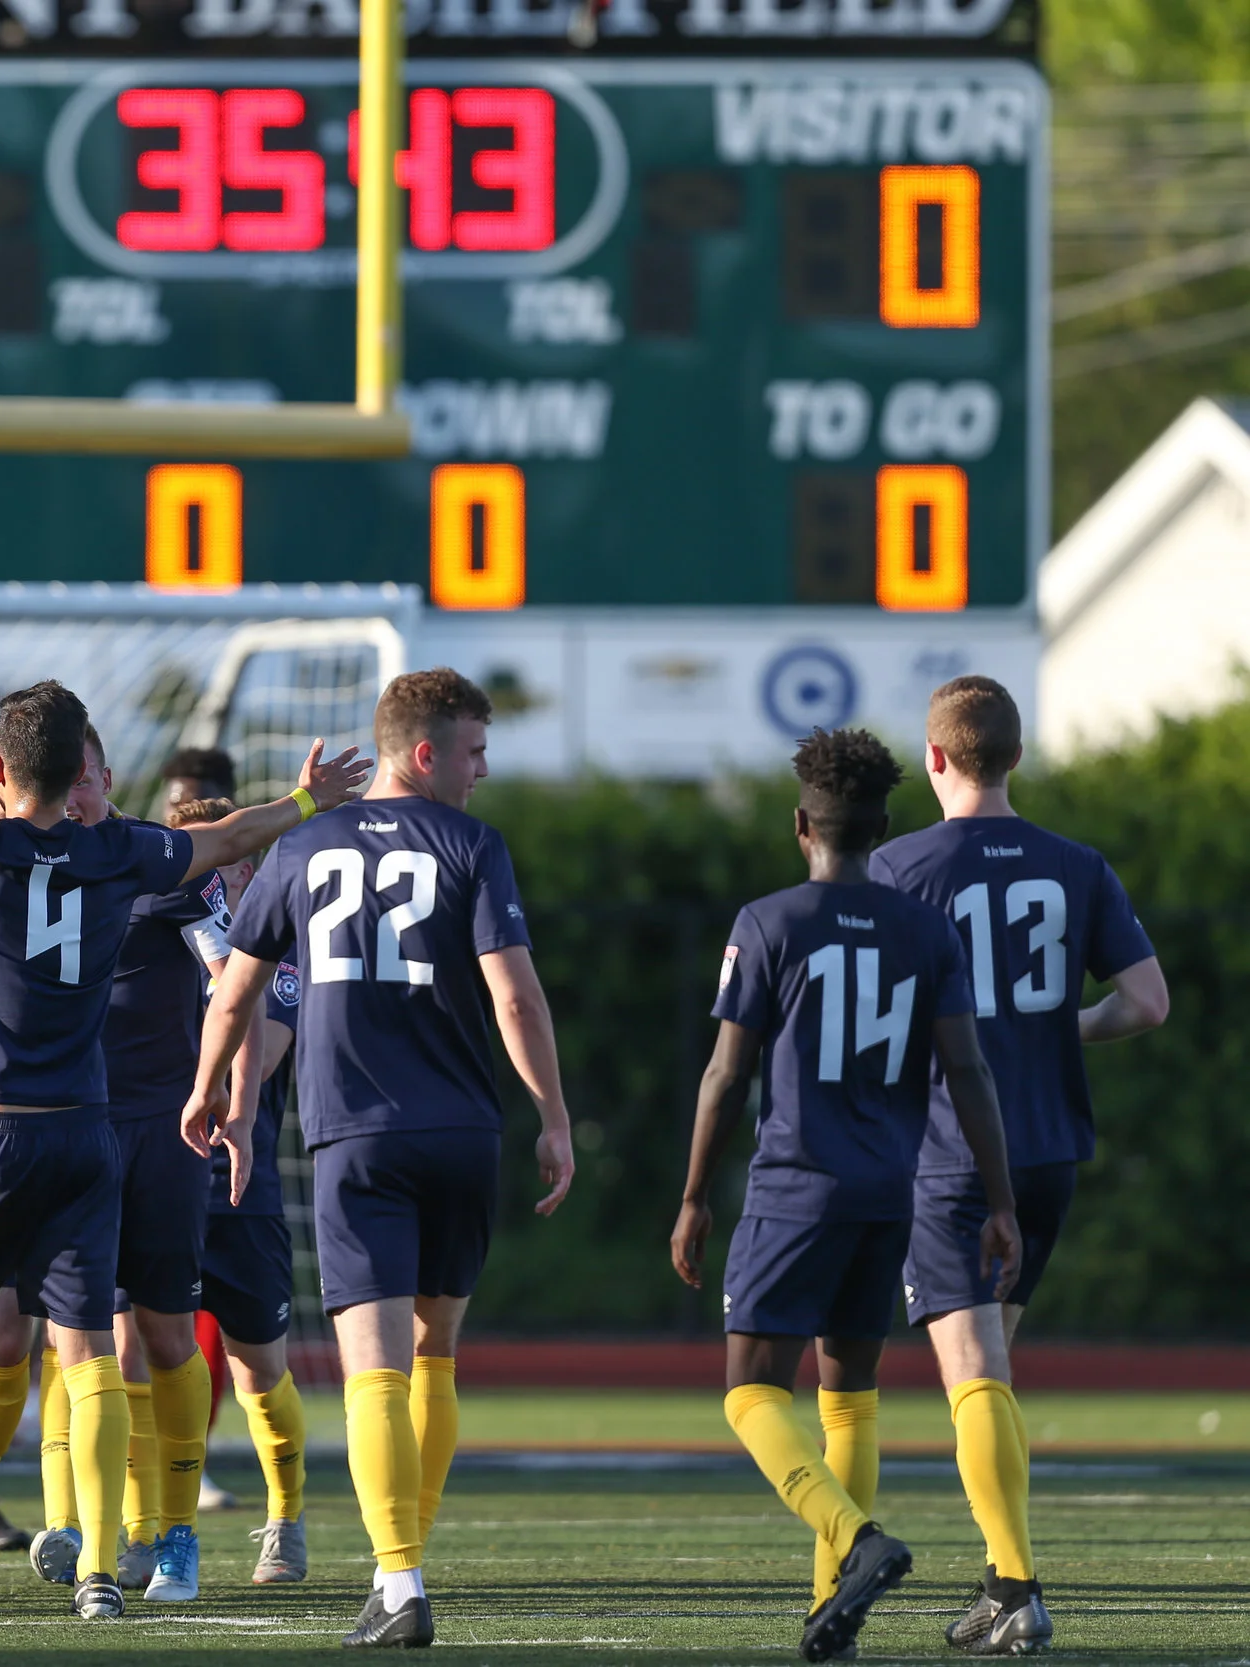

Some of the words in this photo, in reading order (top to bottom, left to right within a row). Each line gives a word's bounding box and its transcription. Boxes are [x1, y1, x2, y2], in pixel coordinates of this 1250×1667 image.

[713, 80, 1028, 164] VISITOR
[879, 164, 981, 328] 0
[394, 378, 613, 459] OWN
[764, 379, 872, 461] TO
[879, 379, 1001, 460] GO
[145, 463, 244, 595] 0
[430, 463, 526, 612] 0
[875, 464, 969, 613] 0
[25, 863, 83, 985] 4
[307, 847, 439, 986] 22
[953, 878, 1067, 1019] 13
[807, 943, 917, 1086] 14
